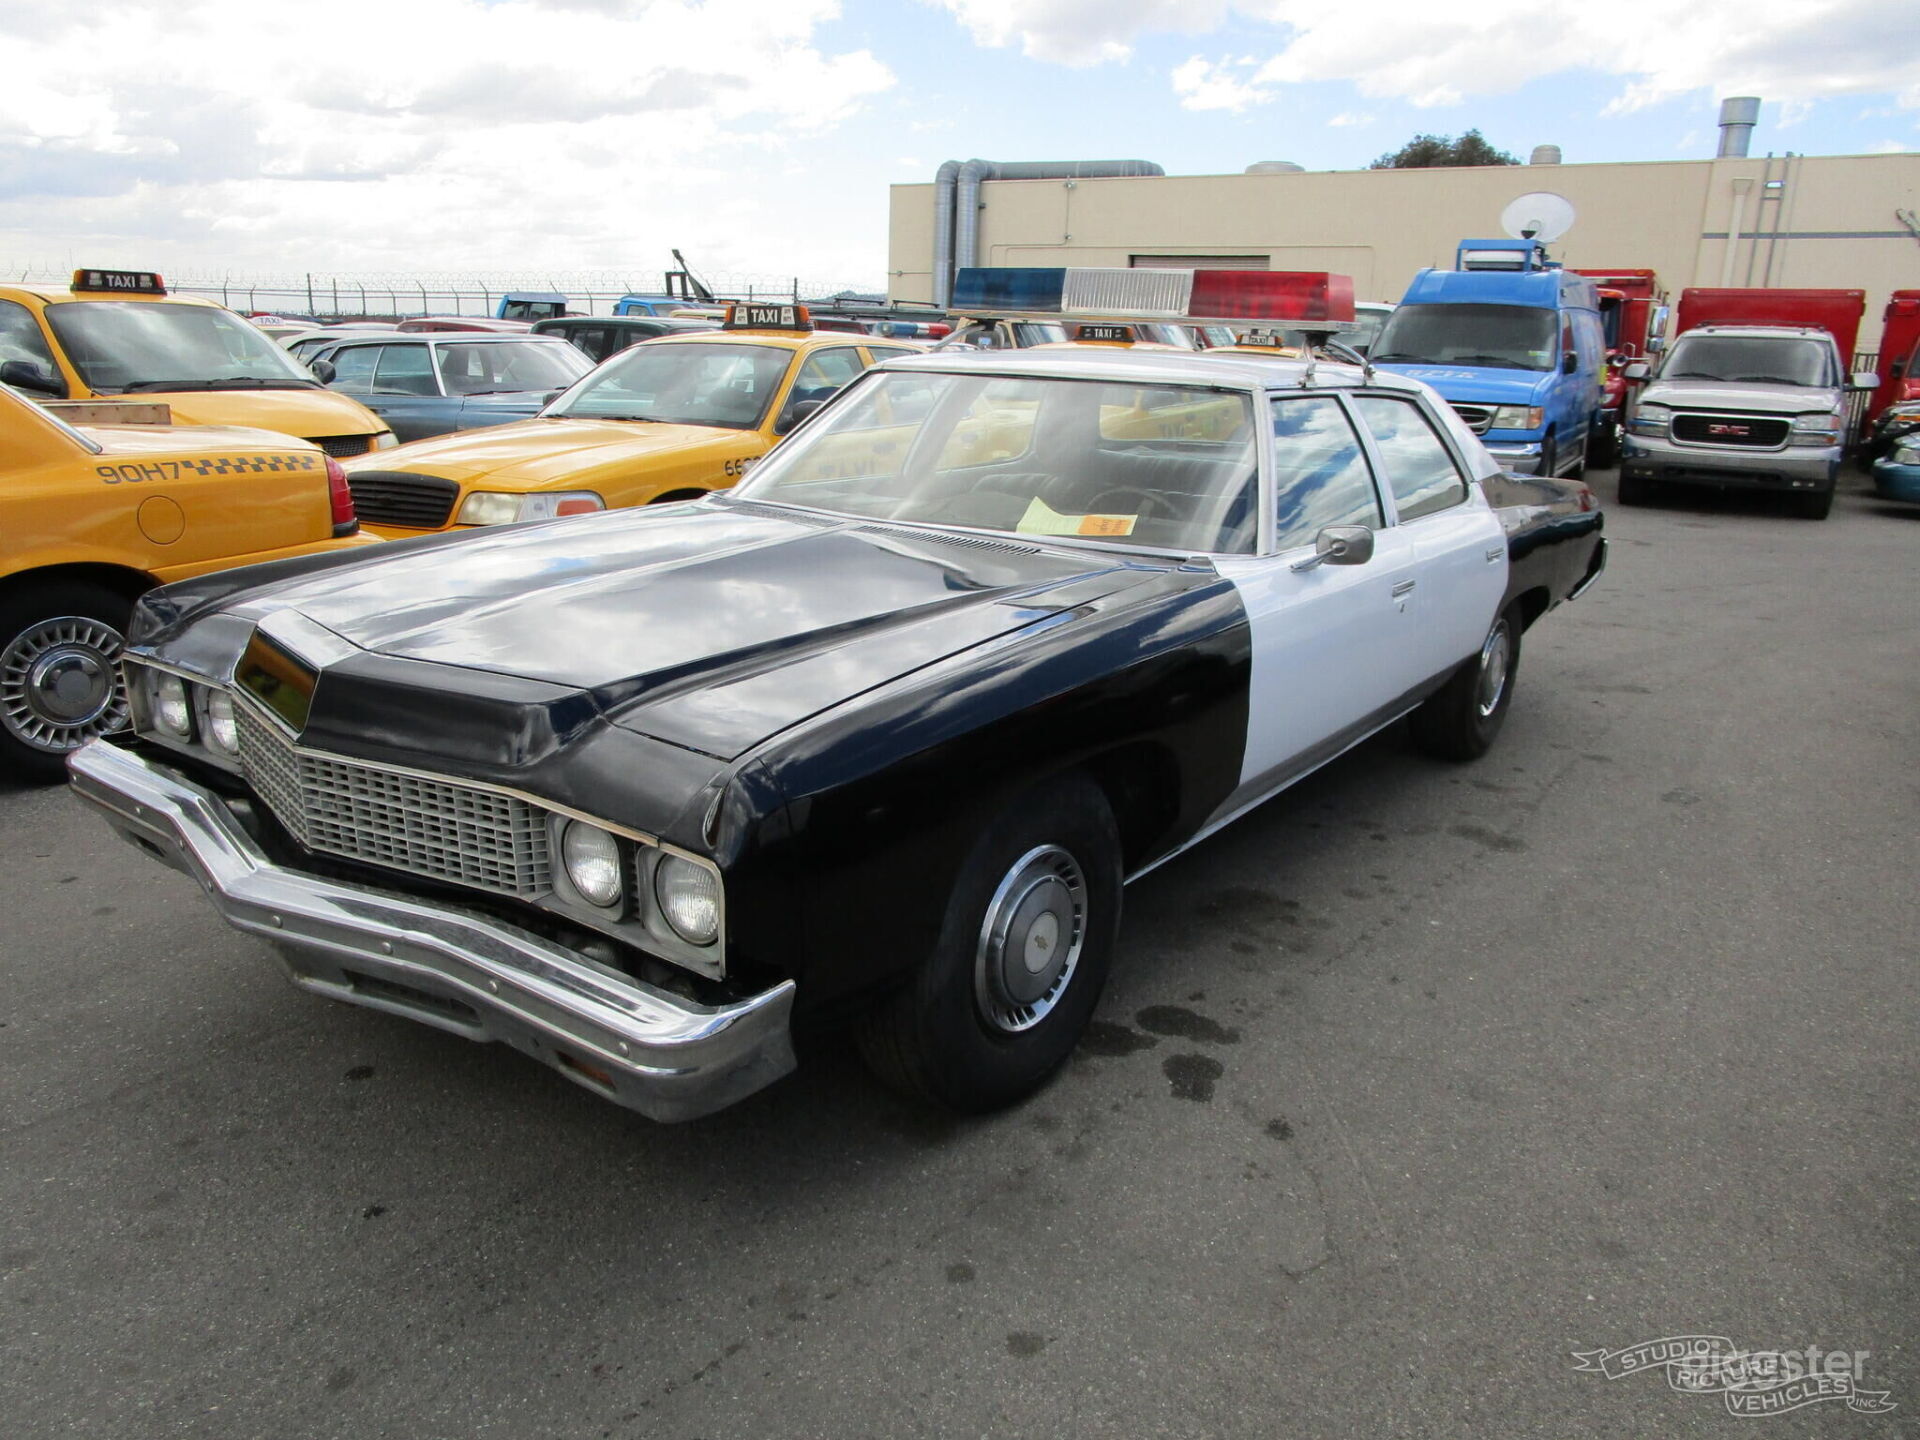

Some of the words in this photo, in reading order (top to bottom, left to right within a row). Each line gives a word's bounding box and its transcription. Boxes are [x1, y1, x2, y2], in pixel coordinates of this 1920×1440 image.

[105, 274, 136, 288] TAXI
[751, 309, 778, 324] TAXI
[1094, 328, 1113, 339] TAXI
[1708, 423, 1751, 436] GMC
[724, 456, 762, 477] 66
